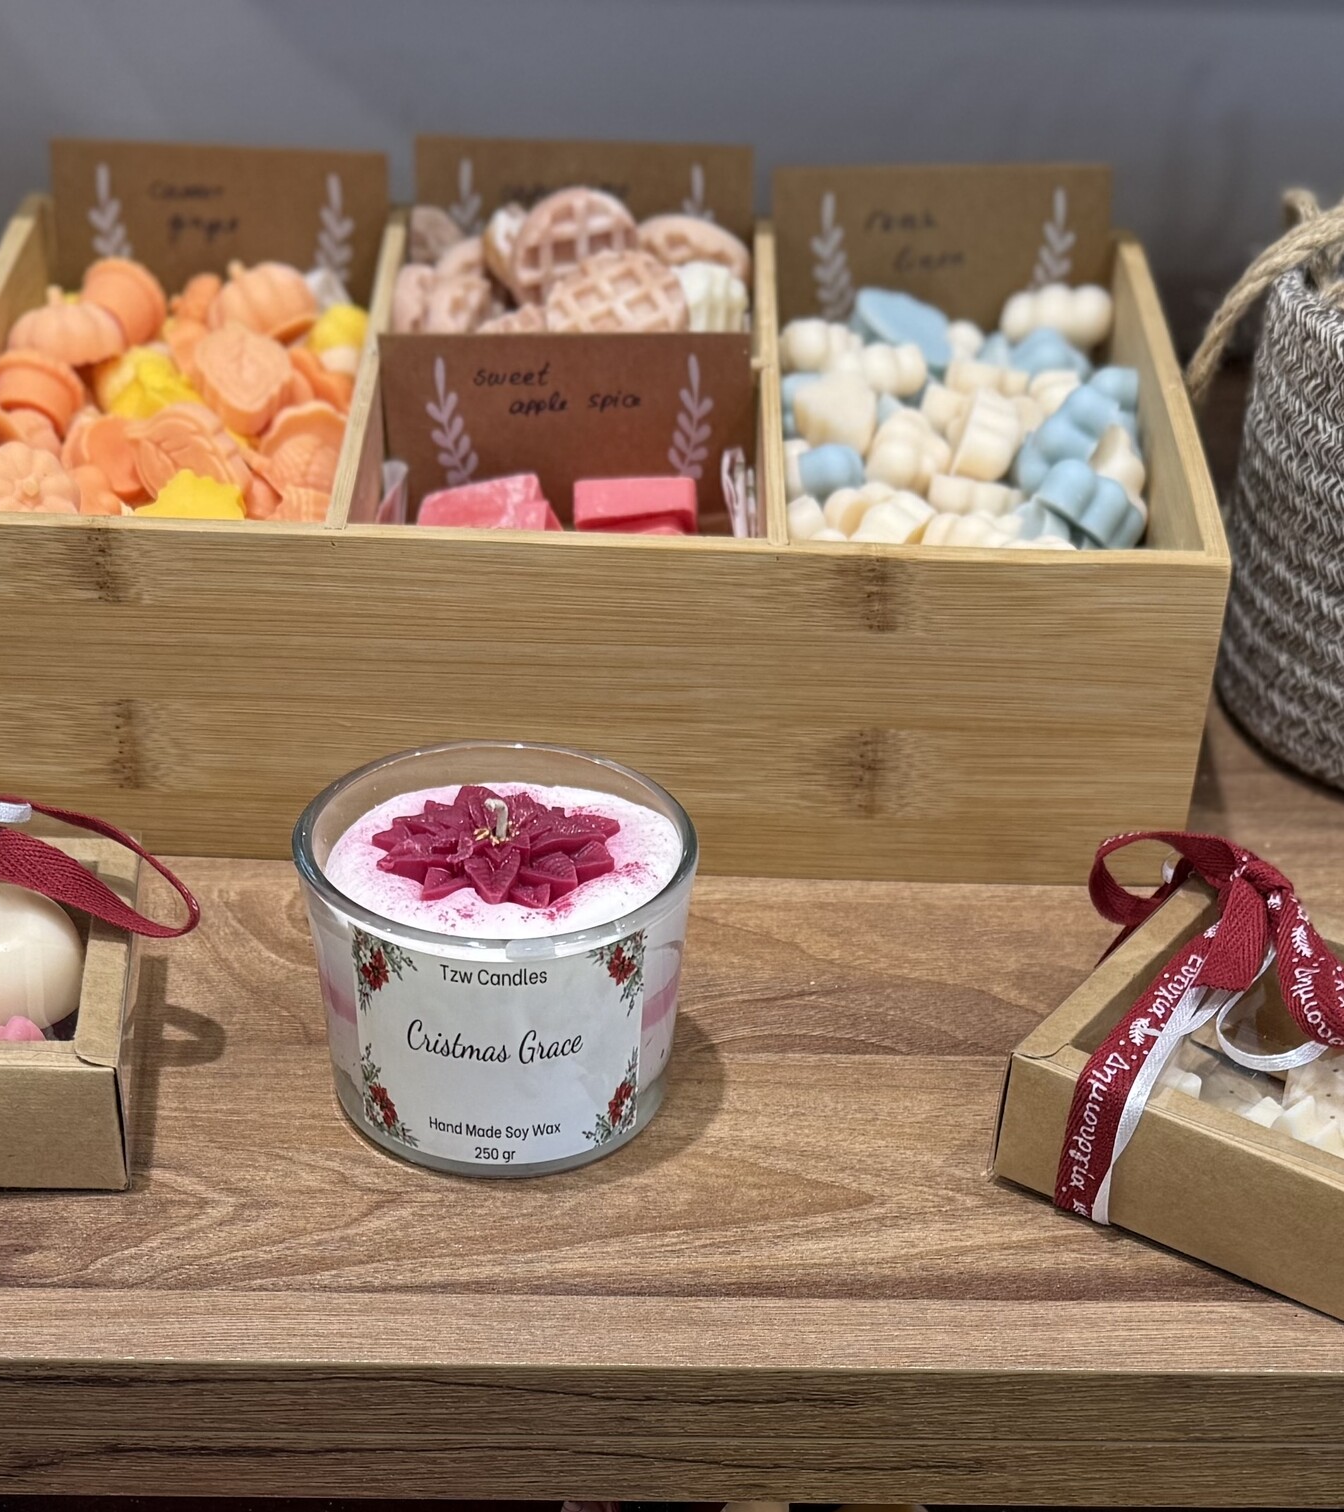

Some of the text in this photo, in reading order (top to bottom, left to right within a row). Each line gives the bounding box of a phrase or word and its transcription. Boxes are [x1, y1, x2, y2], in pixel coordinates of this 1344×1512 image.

[473, 362, 550, 386] sweet
[509, 391, 567, 416] apple
[440, 964, 547, 986] Tzw Candles
[407, 1019, 583, 1064] Cristmas Grace
[429, 1116, 561, 1141] Hand Made Soy Wax
[475, 1147, 516, 1163] 250 gr
